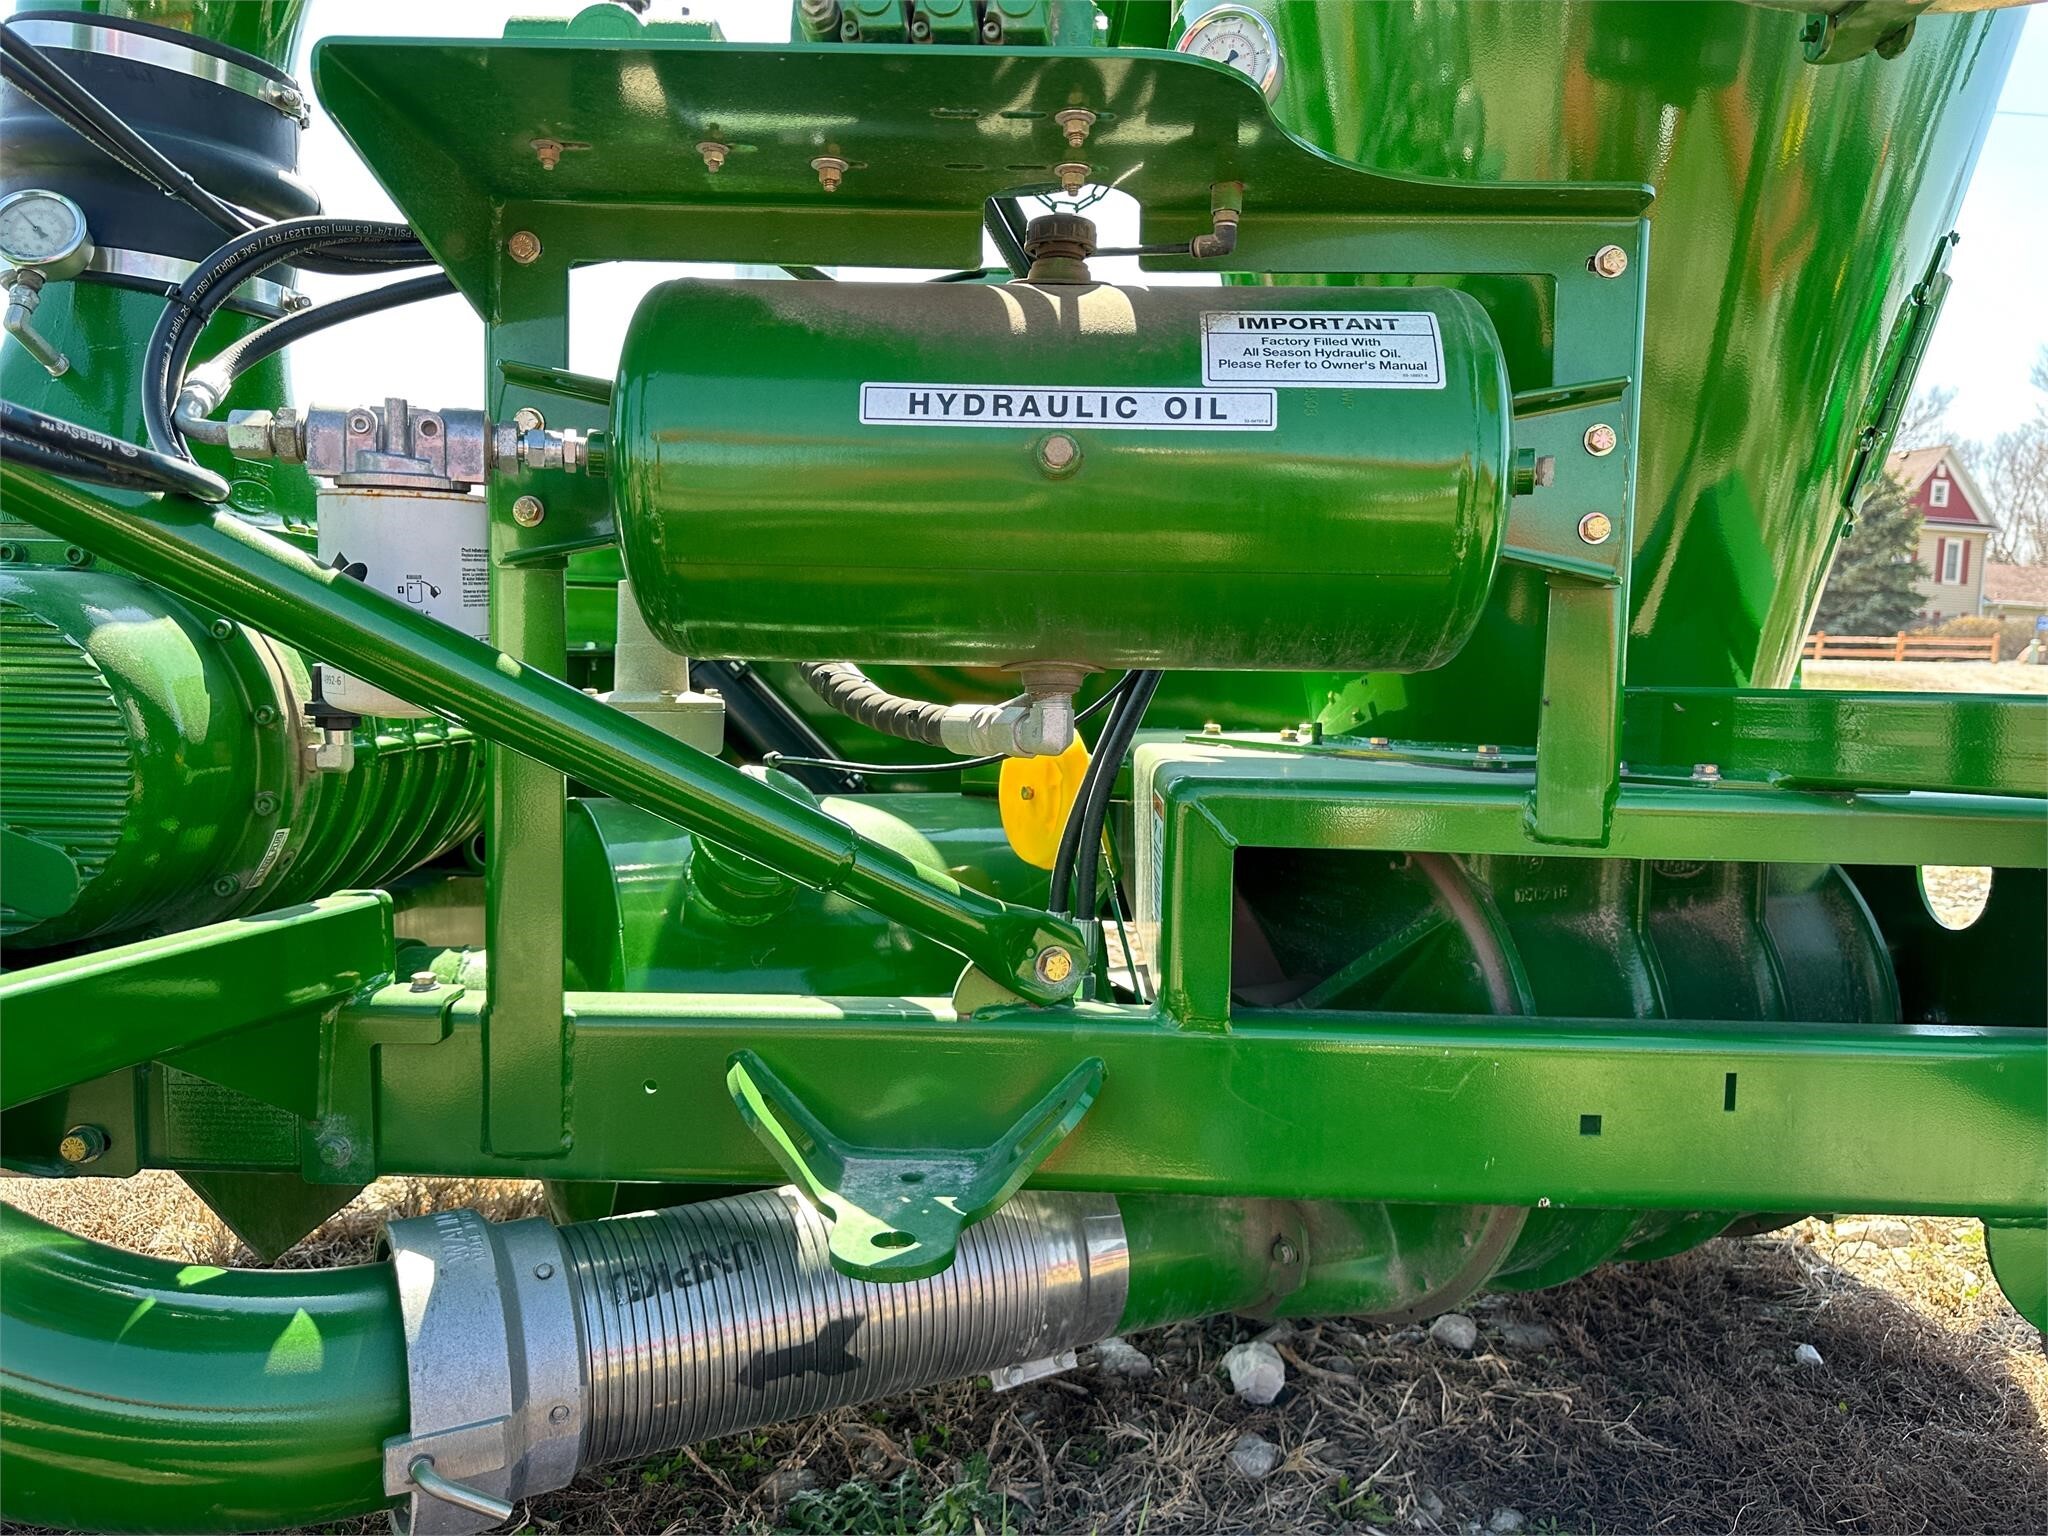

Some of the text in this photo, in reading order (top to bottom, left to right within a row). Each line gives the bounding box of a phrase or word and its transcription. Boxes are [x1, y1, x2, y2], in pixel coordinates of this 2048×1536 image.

[284, 226, 312, 240] 11237
[314, 225, 330, 235] ISO
[265, 233, 282, 247] R17
[240, 243, 258, 257] SAE
[213, 252, 240, 278] 100R17
[196, 279, 210, 294] ISO
[1238, 317, 1399, 330] IMPORTANT
[1261, 336, 1381, 347] Factory Filled With
[1243, 347, 1401, 359] All Season Hydraulic Oil.
[1218, 359, 1427, 370] Please Refer to Owner's Manual
[908, 392, 1228, 419] HYDRAULIC OIL
